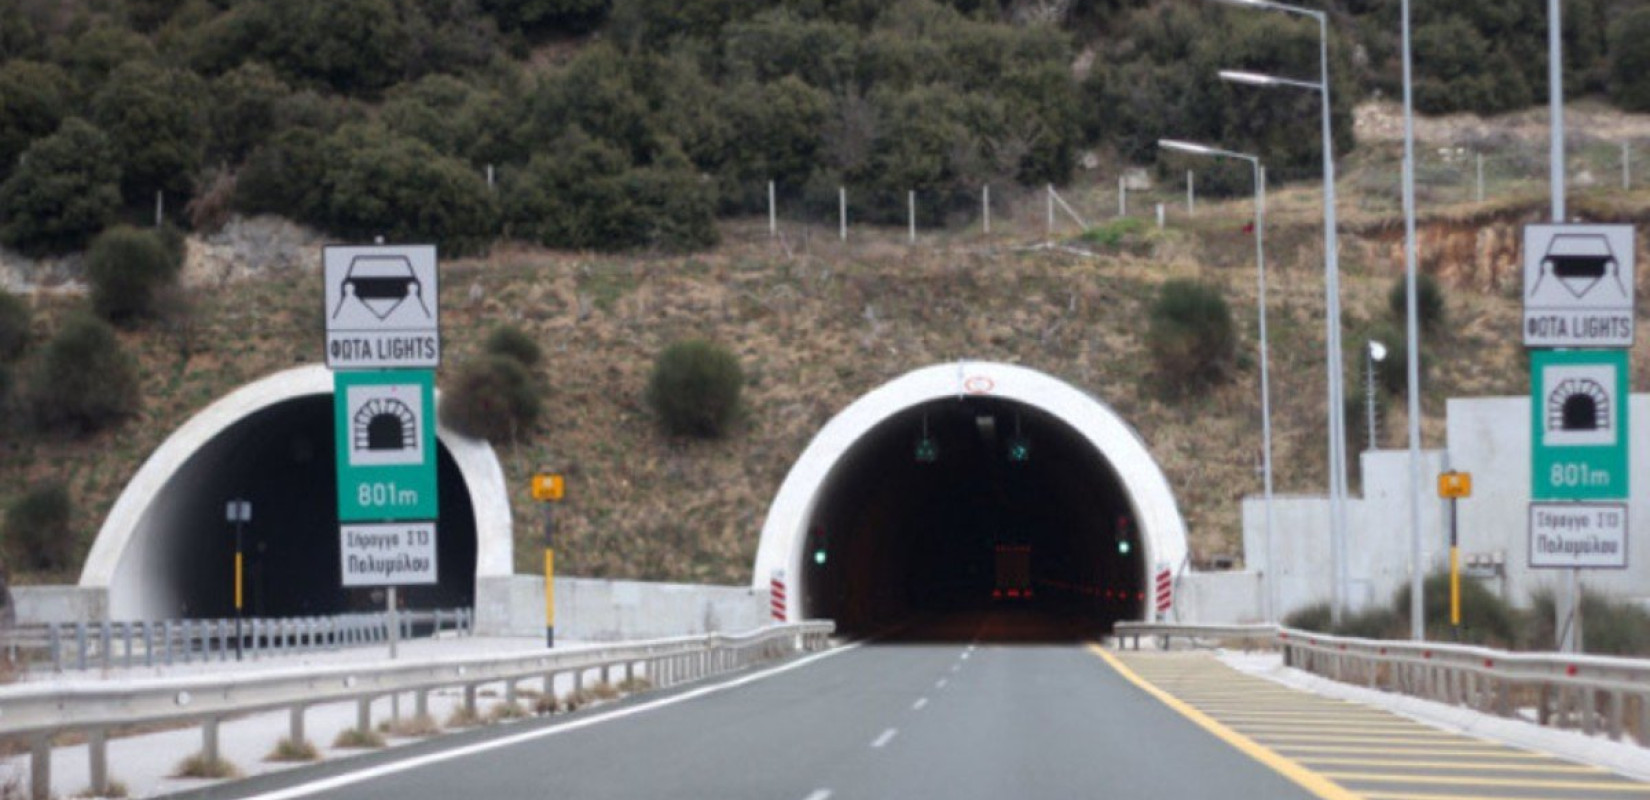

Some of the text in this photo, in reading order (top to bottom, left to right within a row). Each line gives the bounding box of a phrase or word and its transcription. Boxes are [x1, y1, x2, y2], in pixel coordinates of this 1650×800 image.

[1572, 316, 1631, 338] LIGHTS
[331, 337, 436, 360] ΦΩΤΑ LIGHTS
[1550, 462, 1611, 487] 801m
[358, 482, 419, 507] 801m
